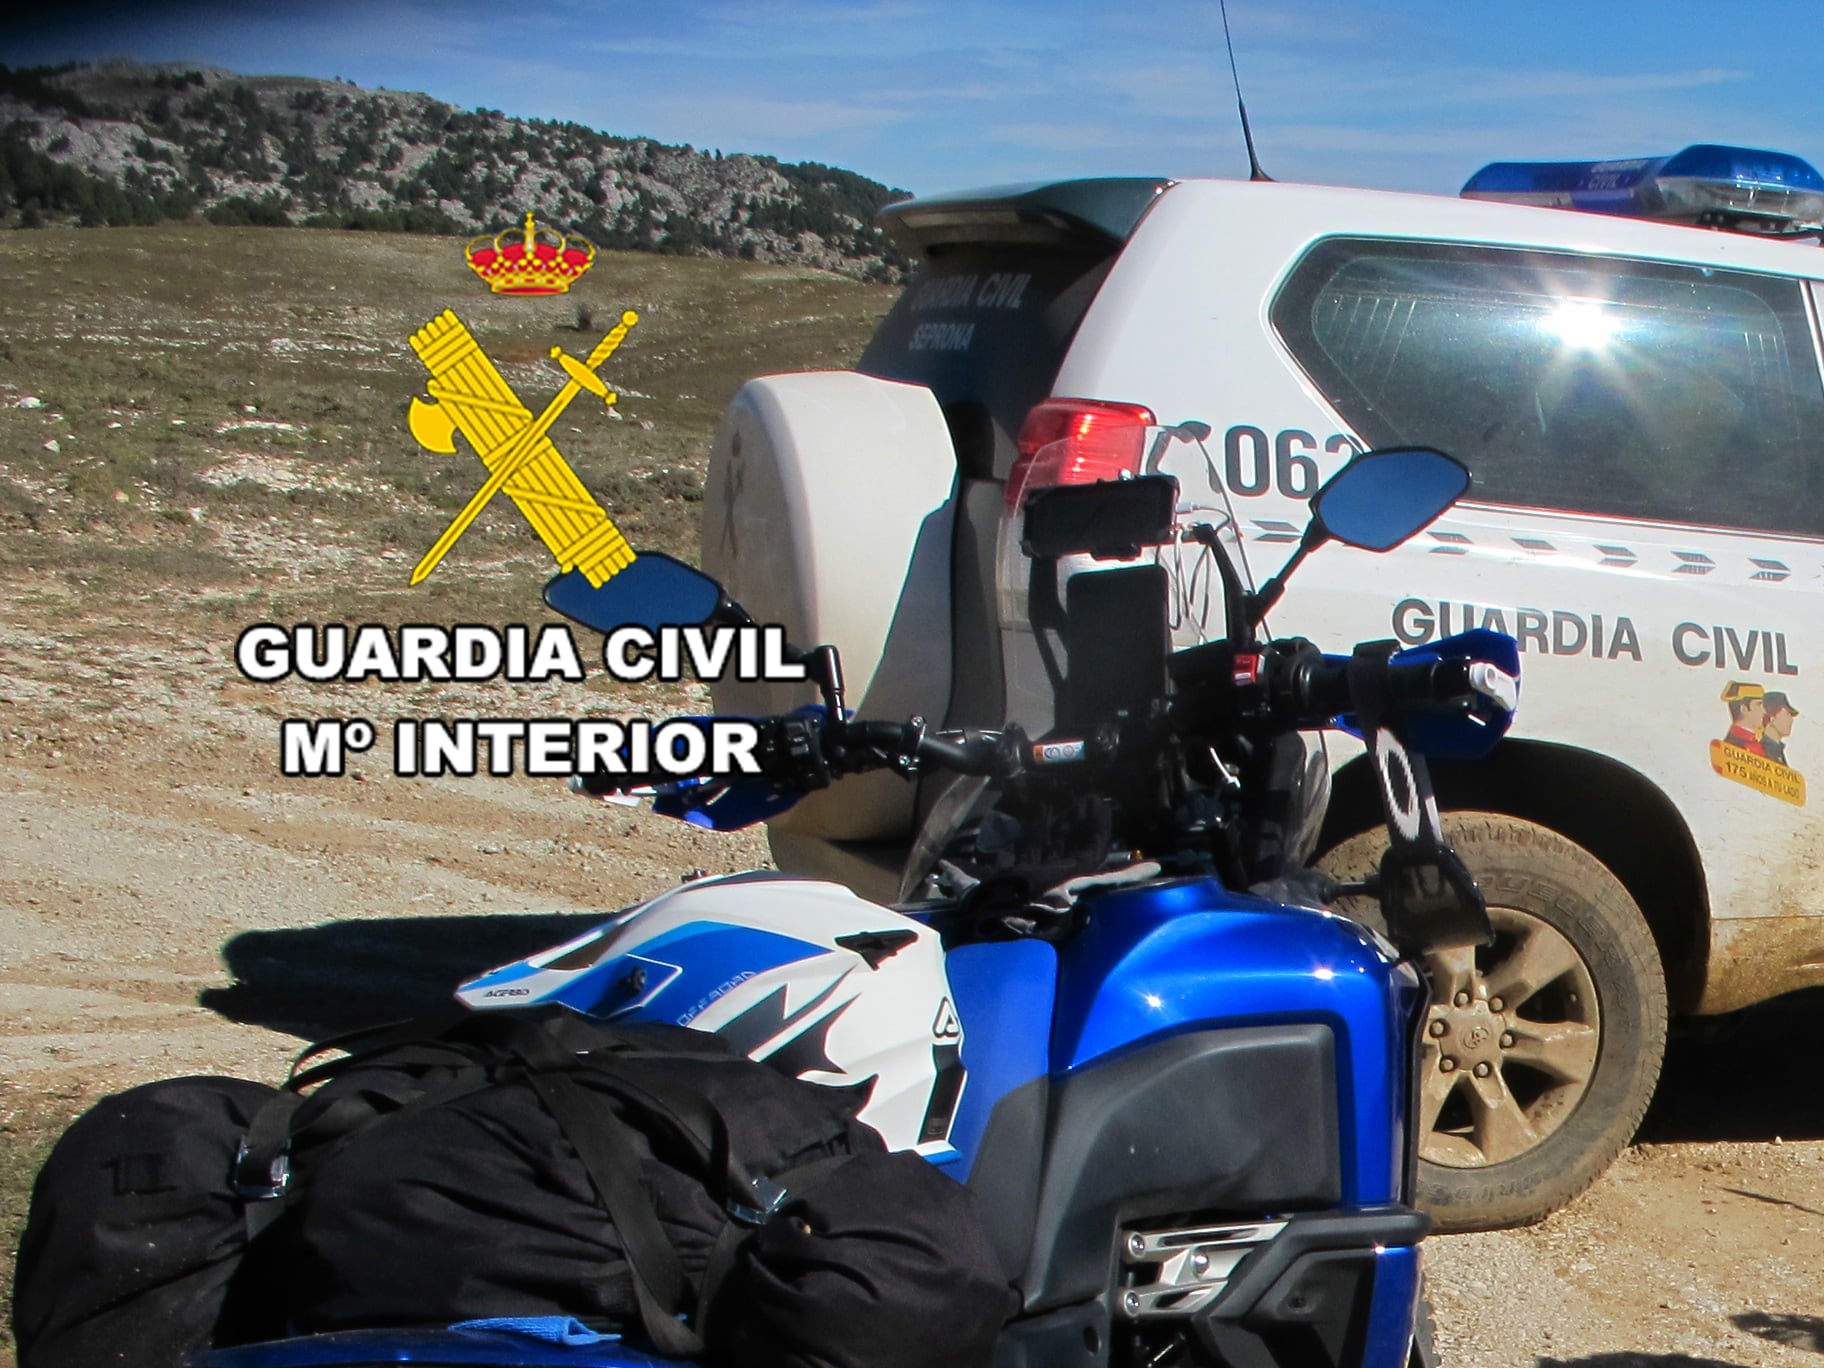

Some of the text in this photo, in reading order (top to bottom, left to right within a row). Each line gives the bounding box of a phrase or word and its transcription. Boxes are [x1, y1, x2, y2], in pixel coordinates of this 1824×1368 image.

[977, 273, 1033, 309] CIVIL
[908, 322, 976, 351] SEPRONA
[1392, 597, 1799, 676] GUARDIA CIVIL
[1723, 747, 1801, 784] GUARDIA CIVIL
[1725, 761, 1748, 778] 175
